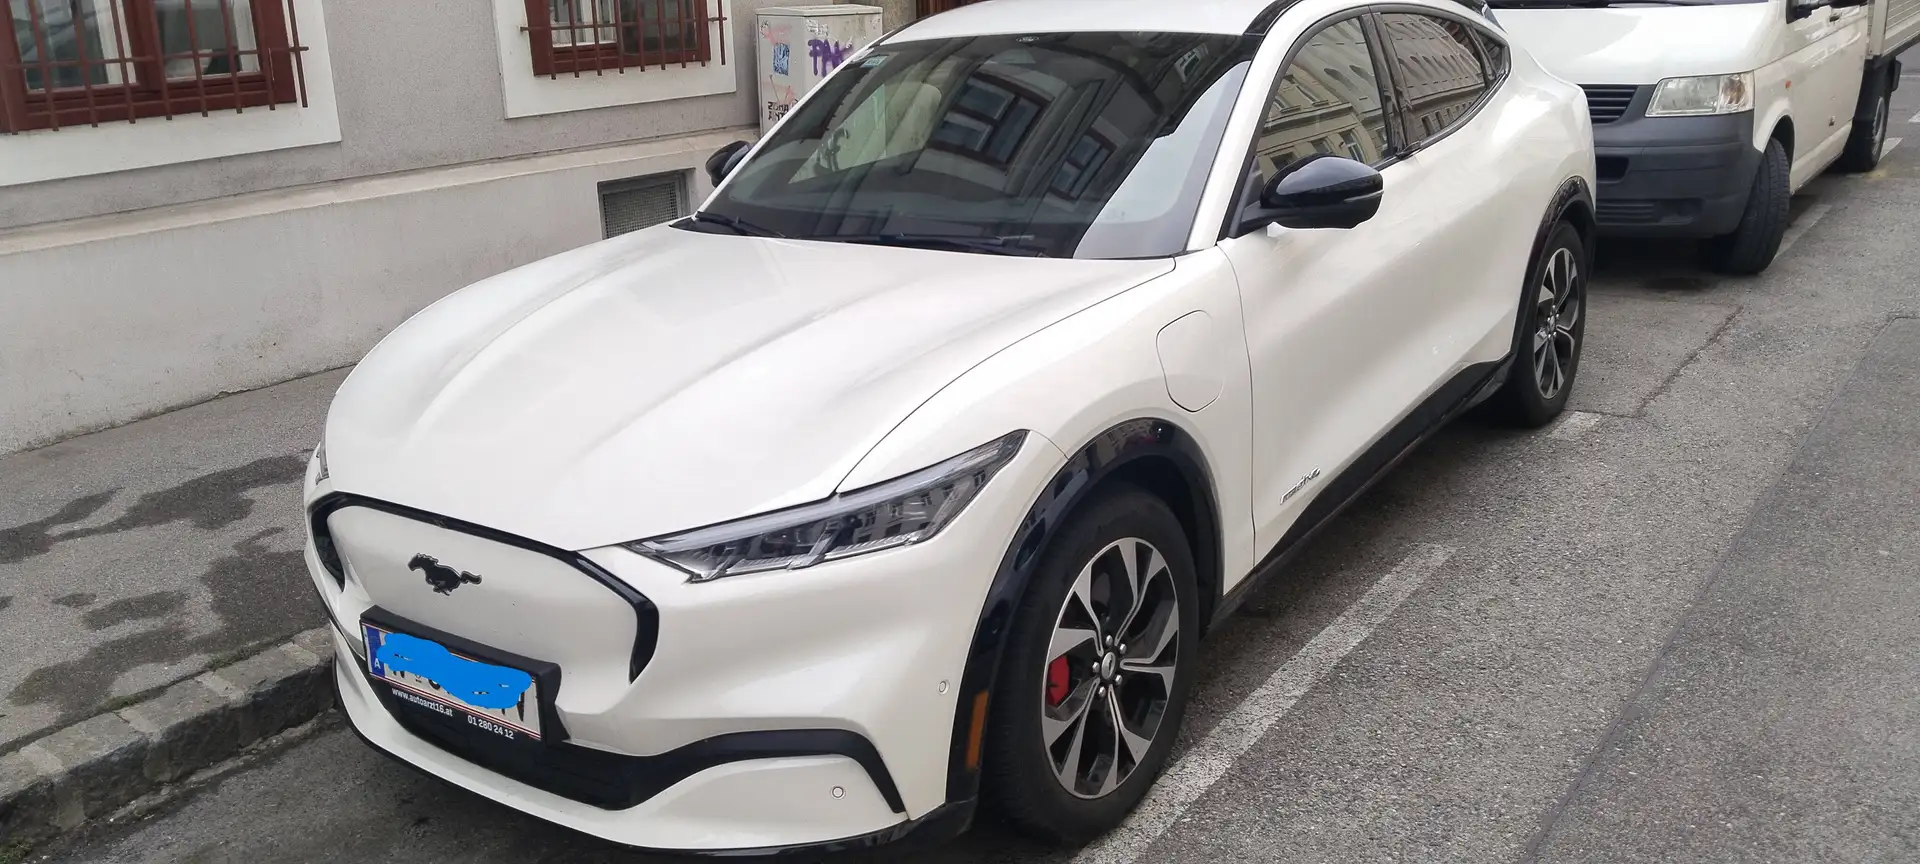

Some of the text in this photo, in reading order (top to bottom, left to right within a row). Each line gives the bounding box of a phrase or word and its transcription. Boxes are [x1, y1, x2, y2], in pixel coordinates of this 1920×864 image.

[374, 657, 381, 670] A
[391, 687, 454, 718] www.autoarzt16.at
[467, 714, 515, 740] 01 280 24 12
